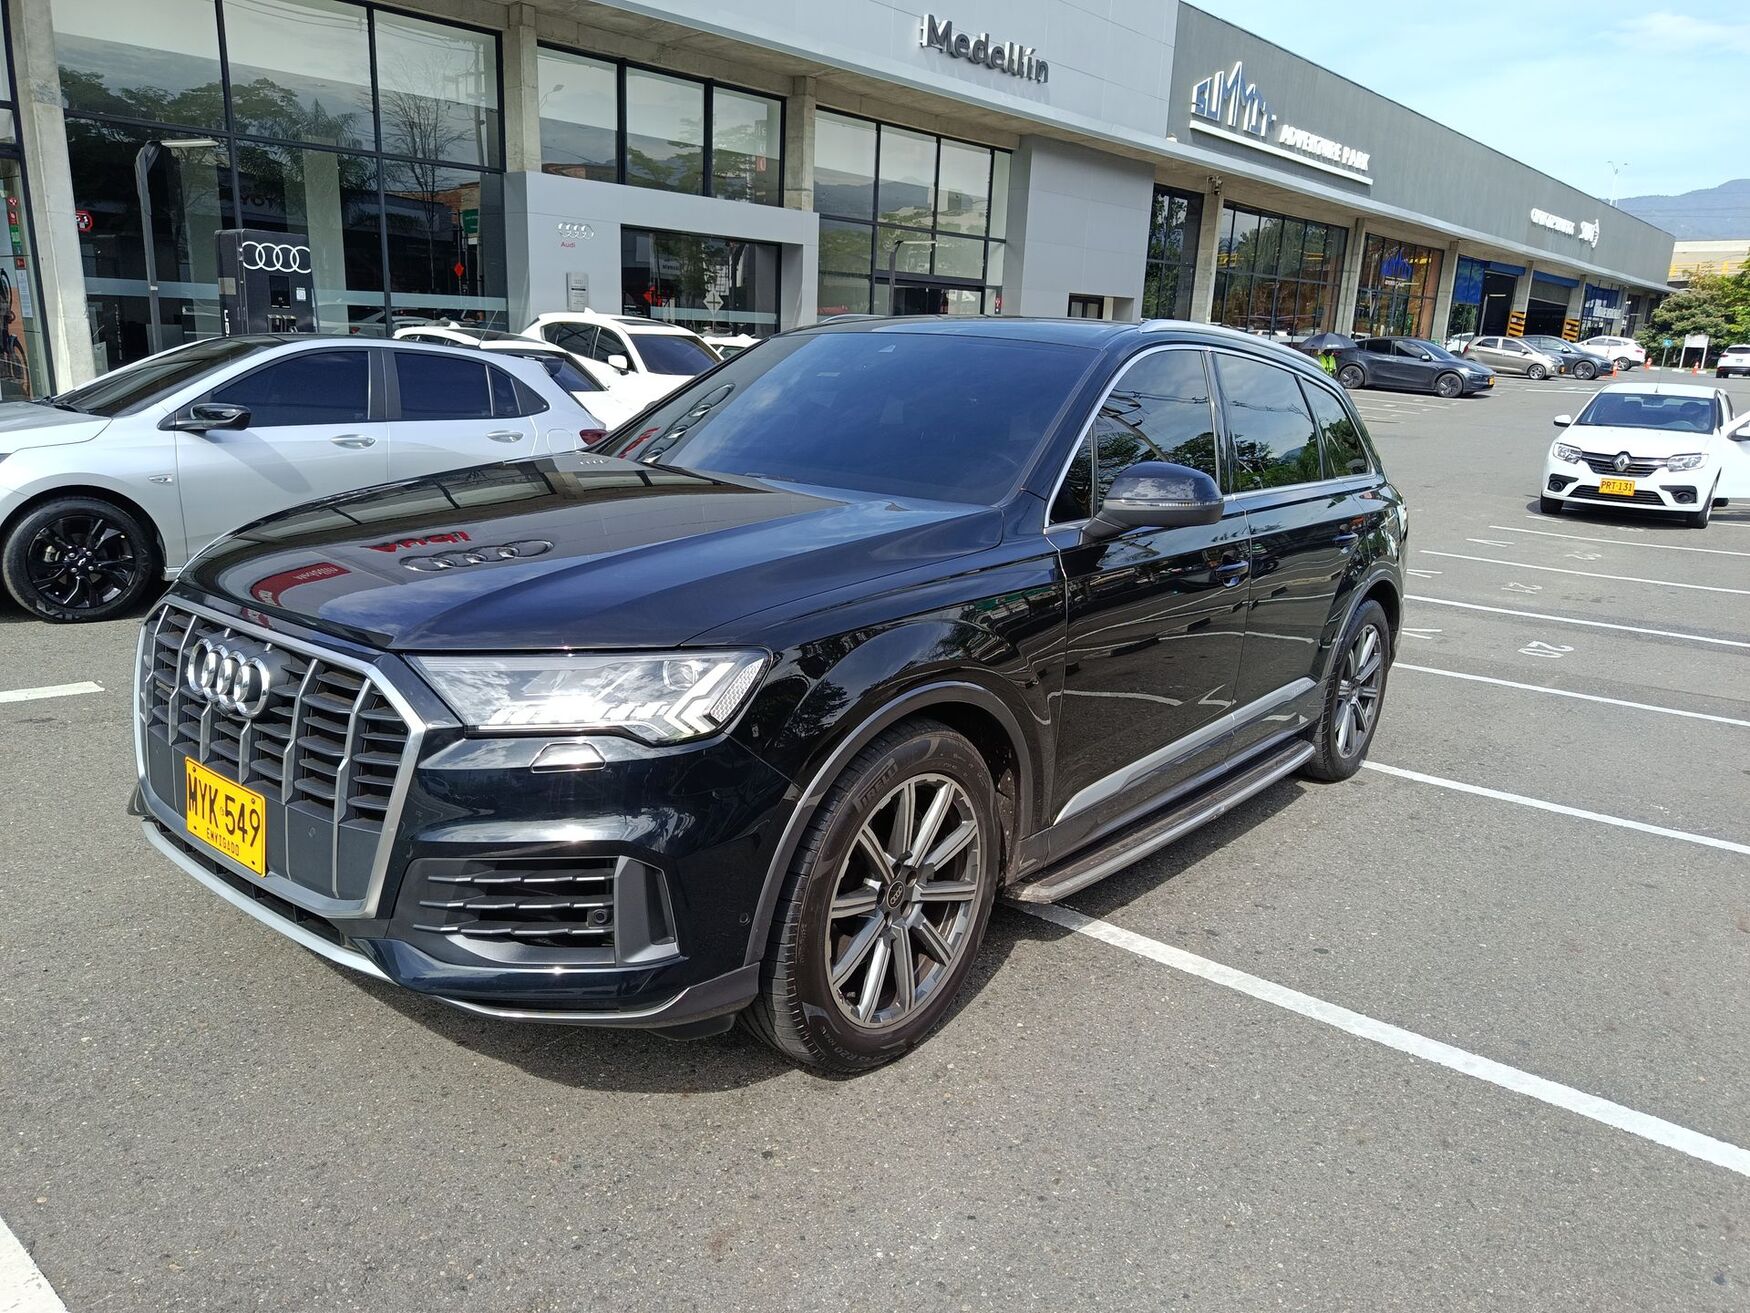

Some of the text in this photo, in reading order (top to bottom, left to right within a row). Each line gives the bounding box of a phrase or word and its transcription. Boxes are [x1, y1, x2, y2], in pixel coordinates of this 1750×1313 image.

[922, 14, 1049, 84] Medellín
[1279, 124, 1370, 171] ADVENTURE PARK
[1600, 480, 1615, 490] PRT
[1618, 483, 1633, 492] 131
[1517, 640, 1575, 659] 20
[188, 772, 262, 848] MYK 549
